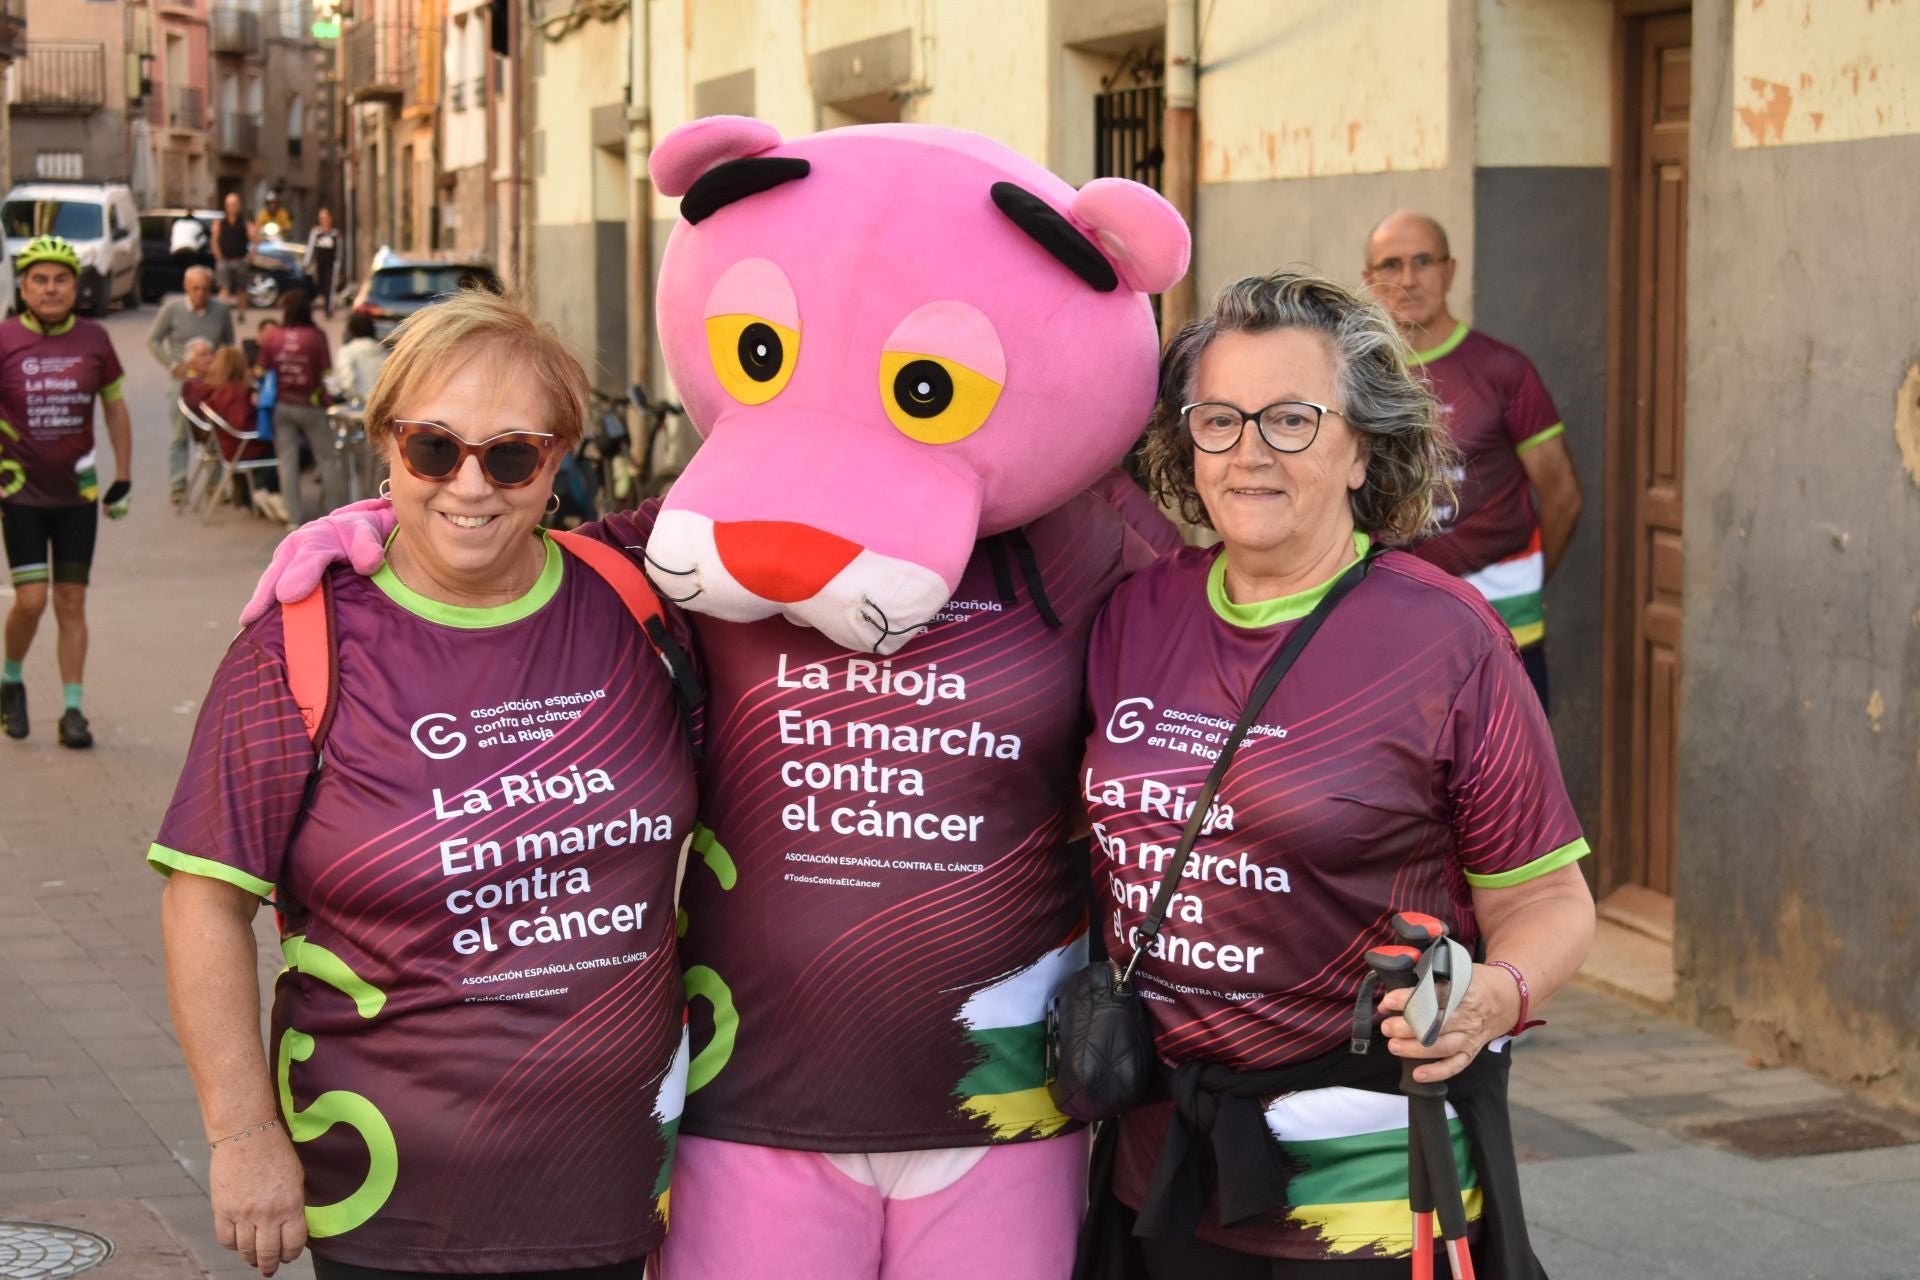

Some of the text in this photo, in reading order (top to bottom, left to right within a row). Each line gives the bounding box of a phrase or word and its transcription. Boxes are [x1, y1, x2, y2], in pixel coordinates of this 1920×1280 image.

[933, 612, 971, 622] ncer
[777, 653, 966, 706] La Rioja
[470, 689, 606, 719] asociación española
[474, 709, 582, 734] contra el cáncer
[478, 727, 554, 748] en La Rioja
[777, 709, 1022, 761] En marcha
[1147, 736, 1222, 764] en La Rioj
[1155, 722, 1202, 738] contra
[1205, 732, 1221, 744] el
[432, 764, 615, 820] La Rioja
[781, 757, 924, 797] contra
[1086, 768, 1126, 809] La
[782, 795, 984, 842] el cáncer
[440, 808, 673, 876] En marcha
[784, 852, 984, 874] ASOCIACIÓN ESPAÑOLA CONTRA EL CÁNCER
[784, 873, 881, 888] #TodosContraElCáncer
[1138, 842, 1291, 893] marcha
[446, 866, 591, 915] contra
[453, 901, 648, 955] el cáncer
[462, 951, 647, 985] ASOCIACIÓN ESPAÑOLA CONTRA EL CÁNCER
[1175, 985, 1211, 997] CONTRA
[1224, 990, 1264, 1001] CÁNCER
